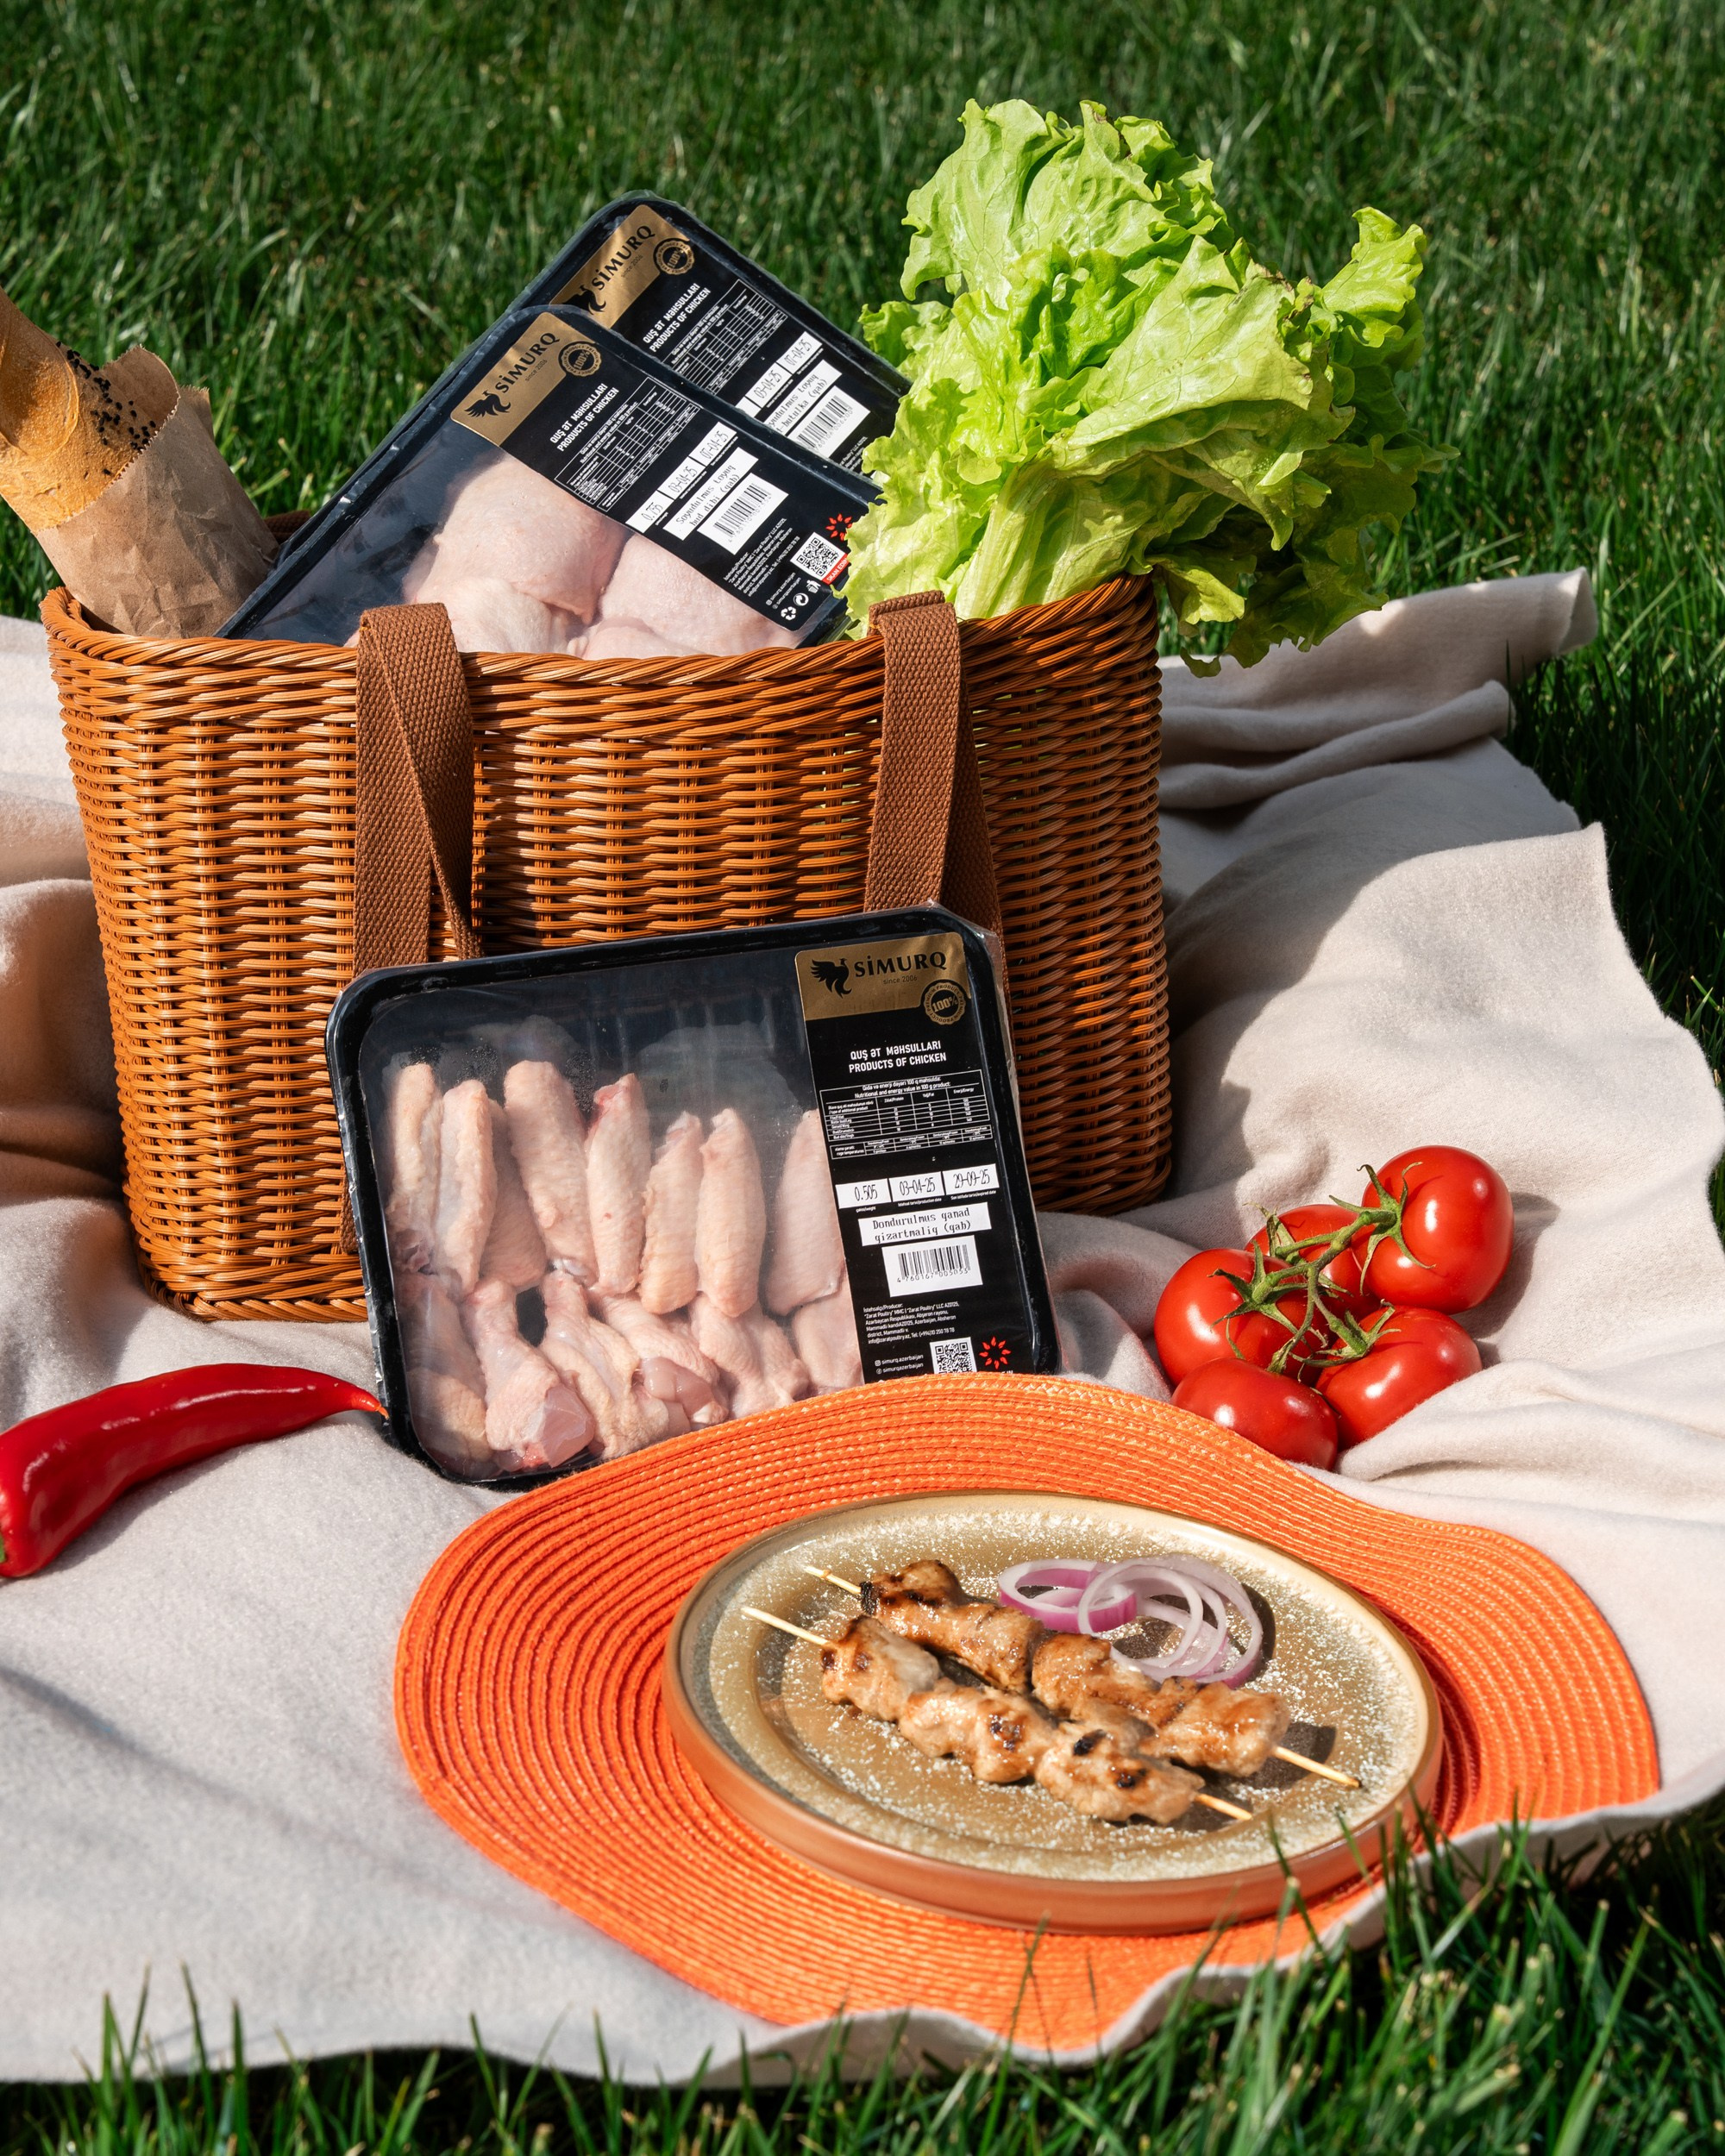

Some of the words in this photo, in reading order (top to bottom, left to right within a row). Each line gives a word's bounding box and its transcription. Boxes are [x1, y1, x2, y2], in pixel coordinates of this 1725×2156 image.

[592, 225, 656, 291] SİMURQ
[649, 320, 681, 353] PRODUCTS
[676, 310, 687, 323] OF
[684, 287, 712, 314] CHICKEN
[643, 329, 659, 343] QUŞ
[495, 332, 560, 393] SİMURQ
[524, 369, 538, 382] since
[535, 359, 548, 371] 2006
[573, 350, 590, 371] 100%
[797, 373, 819, 393] toyuq
[556, 420, 588, 452] PRODUCTS
[584, 411, 595, 422] OF
[592, 386, 619, 414] CHICKEN
[549, 429, 567, 443] QUŞ
[668, 466, 698, 493] 03-04-25
[712, 465, 737, 484] toyuq
[826, 568, 840, 582] SKAN
[854, 950, 948, 978] SİMURQ
[901, 974, 919, 983] 2006
[932, 996, 959, 1012] 100%
[850, 1050, 869, 1061] QUŞ
[886, 1040, 942, 1056] MƏHSULLARI
[848, 1058, 894, 1074] PRODUCTS
[895, 1056, 907, 1068] OF
[909, 1052, 947, 1066] CHICKEN
[899, 1176, 936, 1196] 03-04-25
[953, 1169, 990, 1189] 29-09-25
[854, 1183, 878, 1201] 0.505
[872, 1214, 937, 1230] Dondurulmus
[941, 1206, 970, 1222] qanad
[875, 1225, 940, 1244] qizartmaliq
[944, 1219, 974, 1235] (qab)
